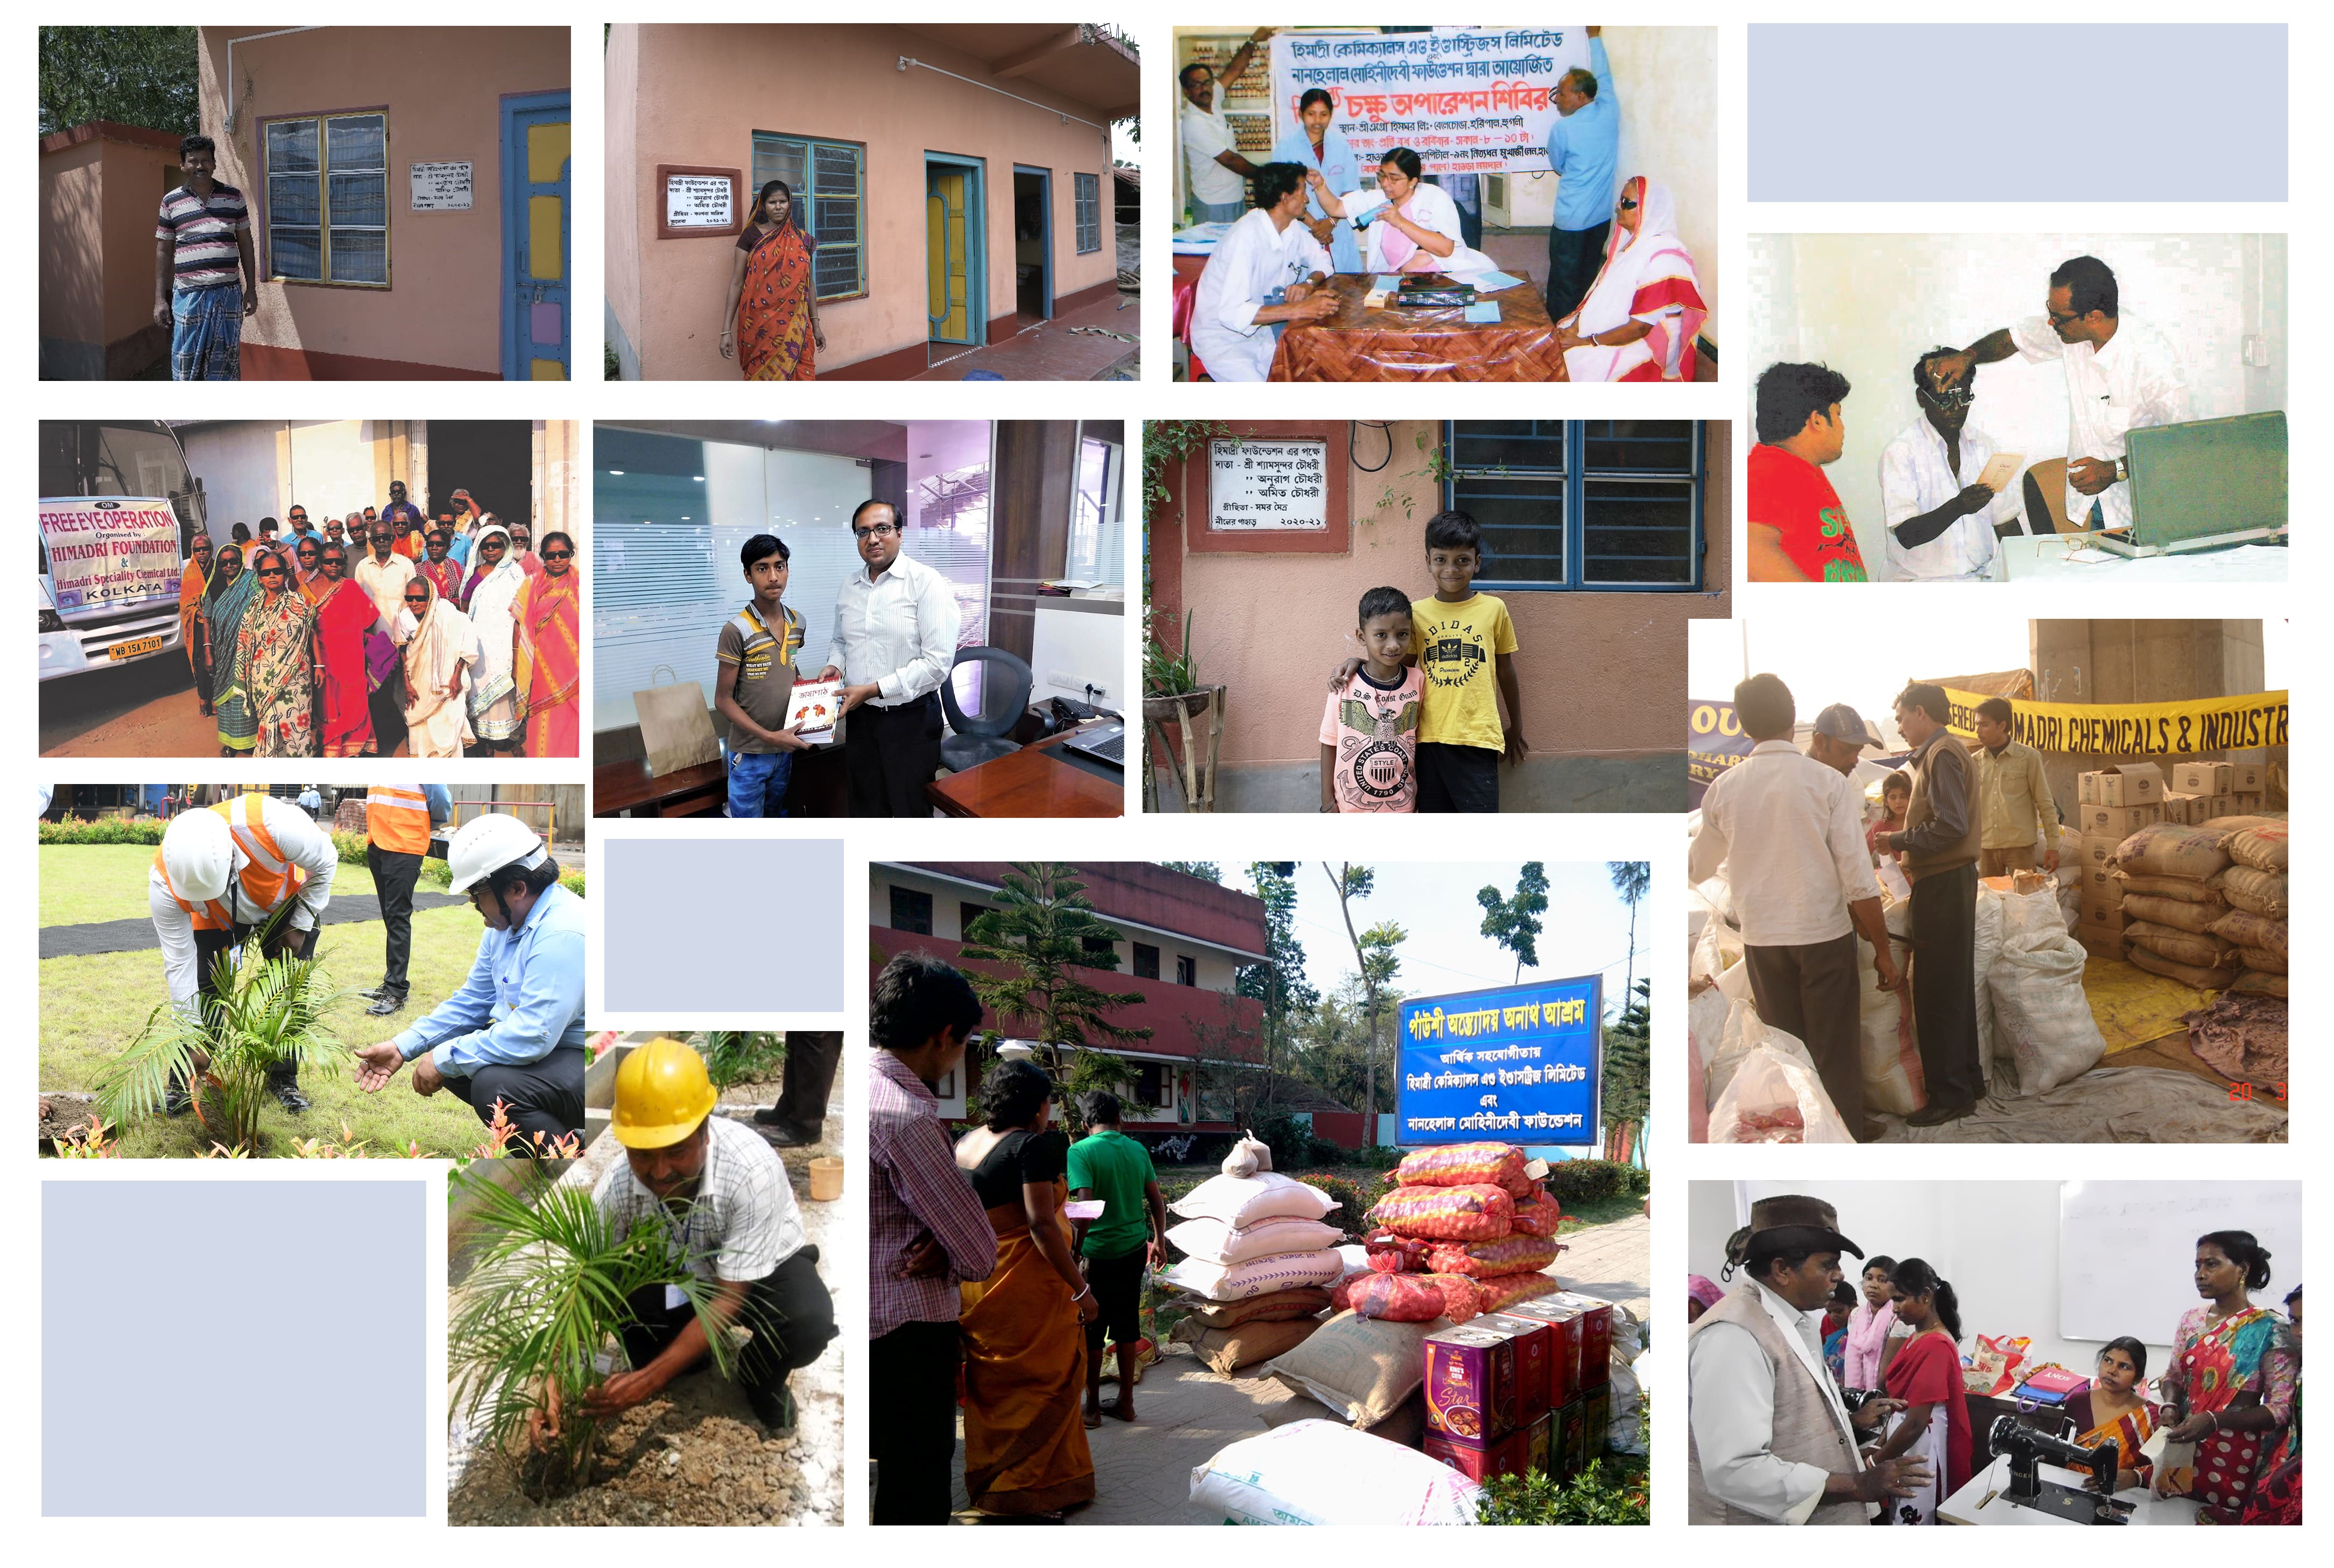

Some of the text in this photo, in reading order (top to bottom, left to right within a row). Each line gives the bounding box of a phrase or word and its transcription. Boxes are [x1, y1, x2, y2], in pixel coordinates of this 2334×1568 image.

[1302, 448, 1320, 456] পক্ষে
[1215, 461, 1233, 469] দাতা
[1244, 458, 1253, 469] শ্রী
[1257, 461, 1293, 472] শ্যামসুন্দর
[1257, 475, 1289, 486] অনুরাগ
[1258, 486, 1287, 497] অমিত
[1255, 504, 1271, 512] সমর
[39, 511, 175, 533] FREE EYE OPERATION
[1215, 516, 1236, 526] নীলের
[52, 540, 177, 562] HIMADRI FOUNDATION
[121, 557, 128, 567] &
[57, 575, 91, 590] Himadri
[94, 571, 134, 586] Speciality
[87, 583, 162, 599] KOLKATA
[1424, 620, 1483, 645] ADIDAS
[143, 640, 160, 651] 7101
[1399, 689, 1418, 701] Guard
[2068, 716, 2170, 754] CHEMICALS
[2177, 716, 2192, 752] &
[1358, 745, 1385, 764] STATES
[1356, 766, 1371, 791] UNITED
[1503, 1000, 1541, 1030] অনাথ
[1542, 996, 1585, 1028] আশ্রম
[1440, 1048, 1474, 1065] আর্থিক
[1544, 1063, 1586, 1083] লিমিটেড
[1480, 1094, 1498, 1108] এবং
[1459, 1111, 1521, 1131] মোহিনীদেবী
[2044, 1372, 2071, 1382] SONY
[1438, 1387, 1475, 1407] Star
